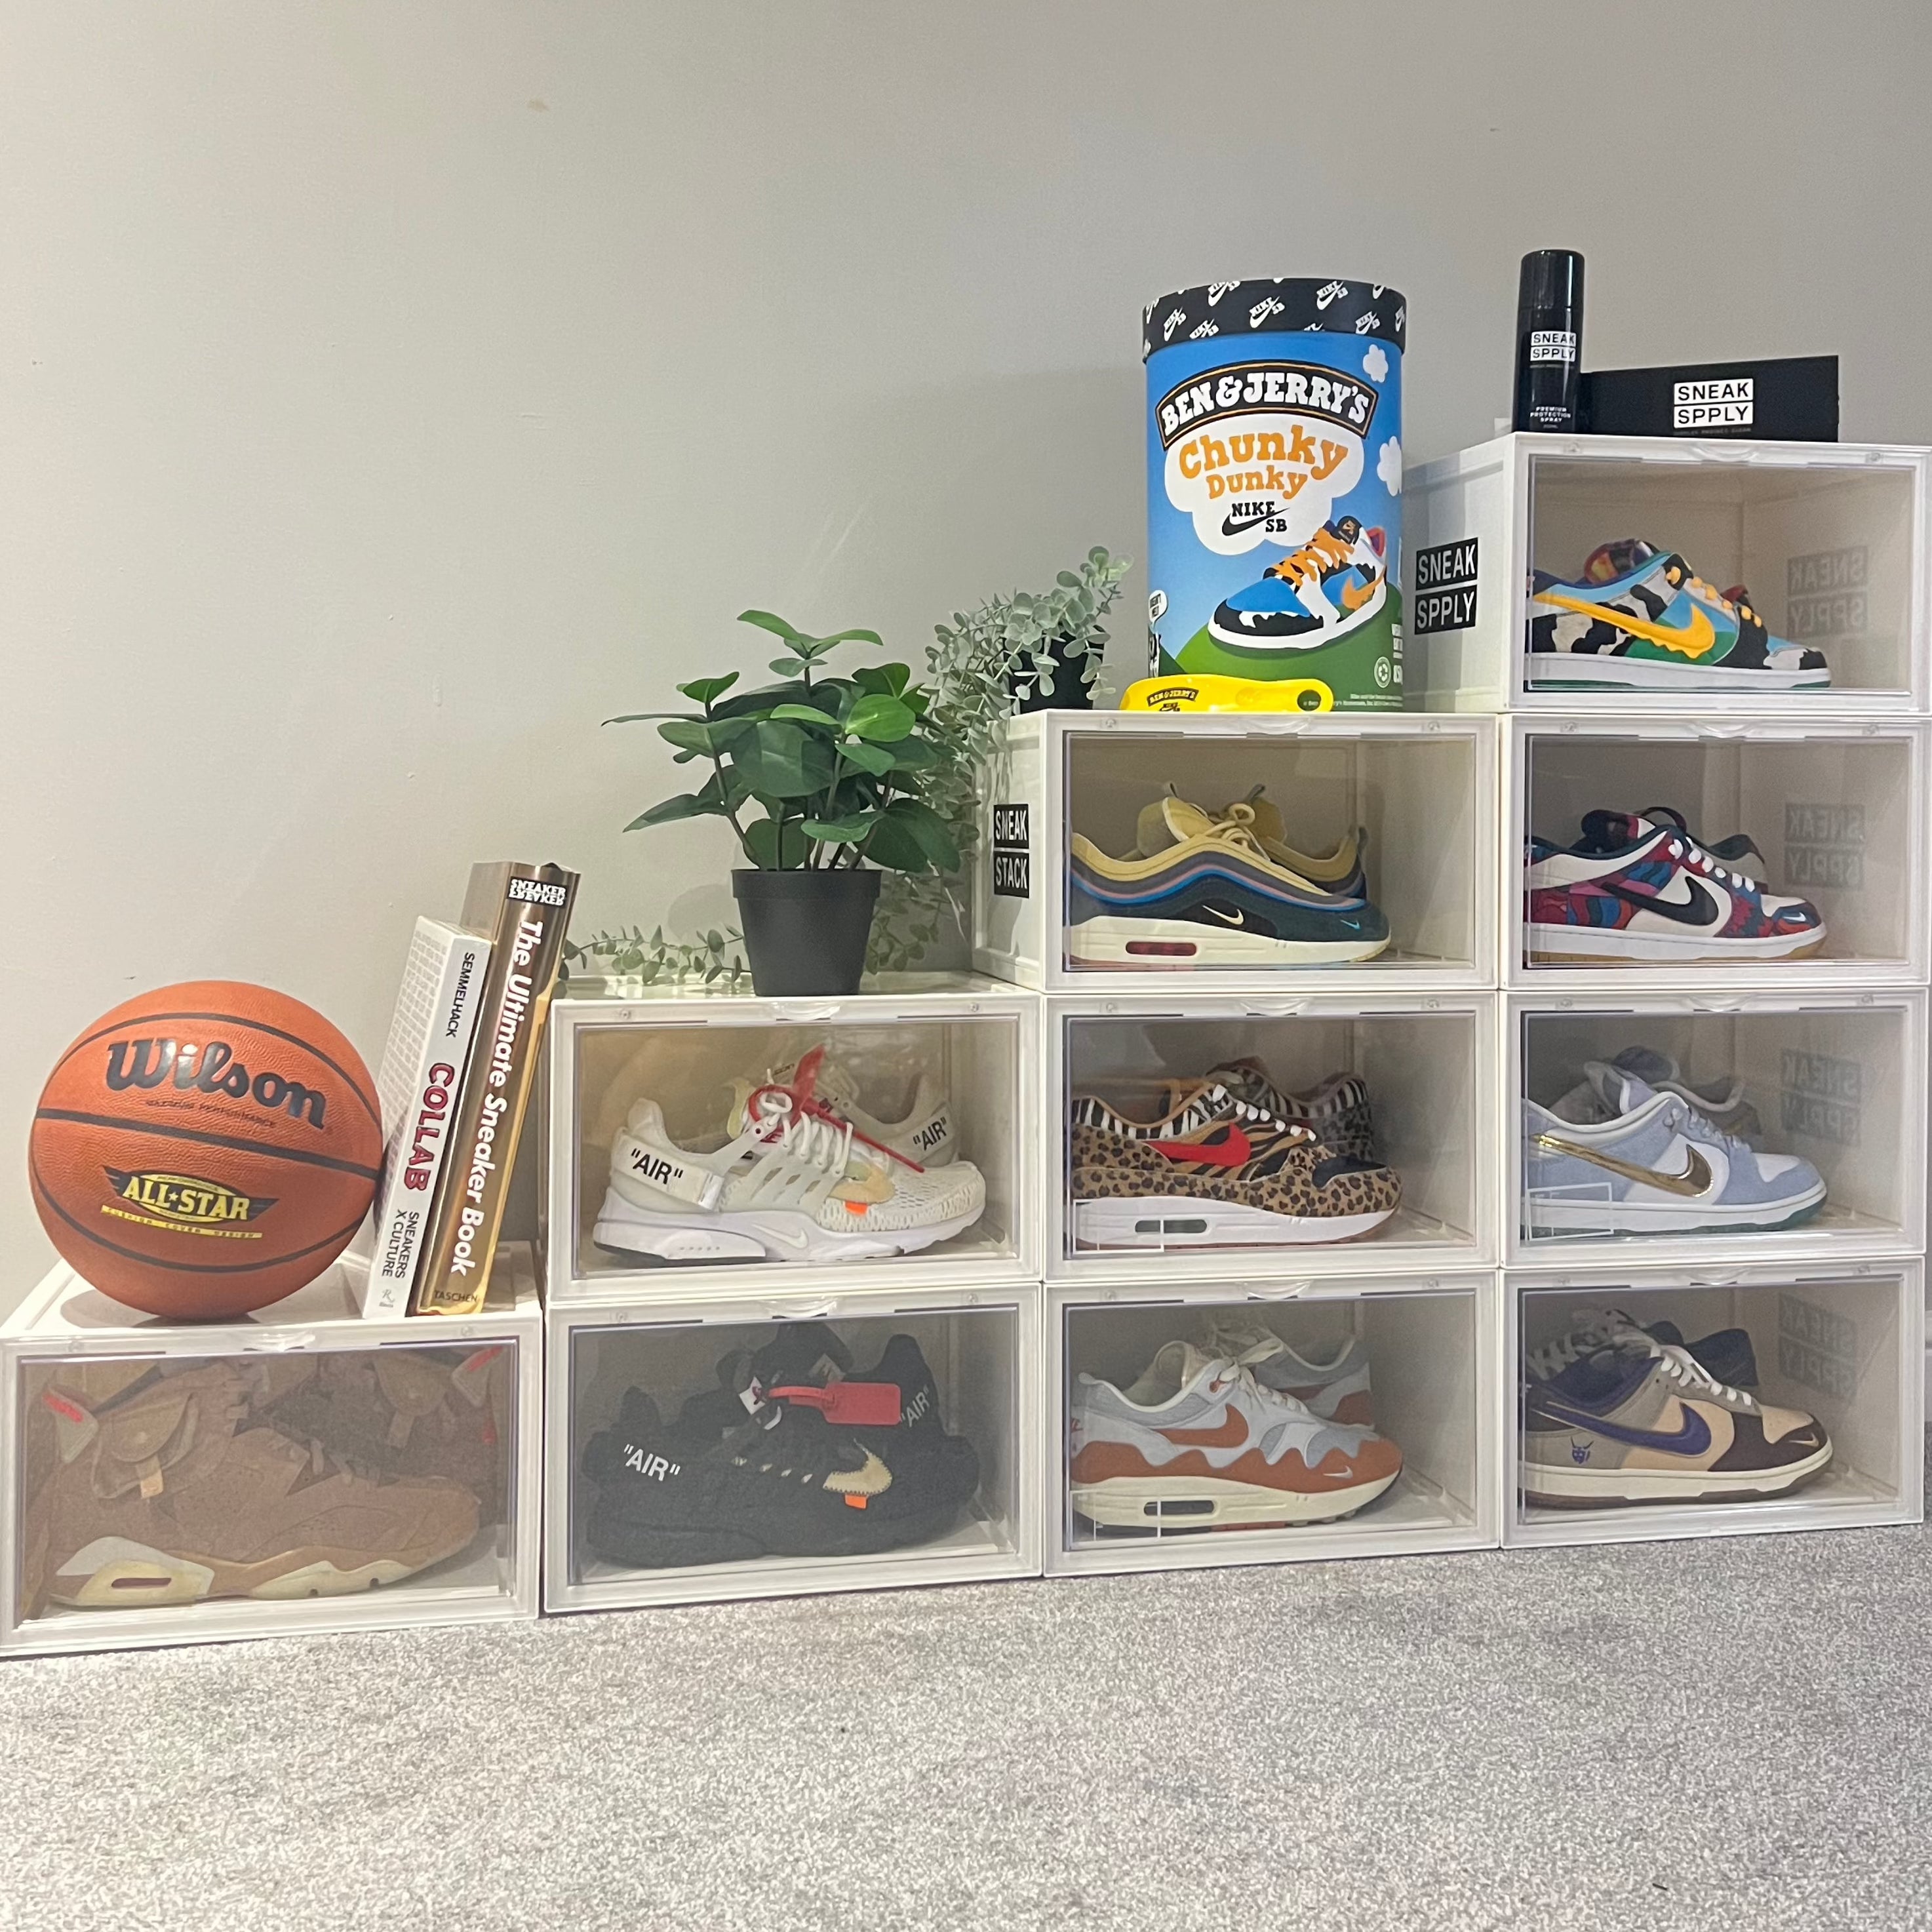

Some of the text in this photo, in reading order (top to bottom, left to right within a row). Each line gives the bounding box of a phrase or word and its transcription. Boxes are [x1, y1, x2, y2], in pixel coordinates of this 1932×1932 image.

[1249, 297, 1273, 317] NIKE
[1533, 333, 1575, 344] SNEAK
[1533, 348, 1575, 359] SPPLY
[1160, 372, 1369, 437] BEN & JERRY'S
[1678, 382, 1749, 401] SNEAK
[1678, 405, 1748, 424] SPPLY
[1179, 424, 1349, 481] Chunky
[1206, 465, 1309, 500] Dunky
[1231, 501, 1275, 517] NIKE
[1265, 519, 1288, 532] SB
[1418, 544, 1476, 585] SNEAK
[1417, 591, 1474, 629] SPPLY
[995, 810, 1027, 840] SNEAK
[511, 878, 566, 897] SNEAKER
[995, 856, 1027, 889] STACK
[445, 952, 475, 1038] SEMMELHACK
[106, 1037, 326, 1130] Wilson
[450, 921, 544, 1277] The Ultimate Sneaker Book
[404, 1061, 456, 1192] COLLAB
[913, 1116, 947, 1151] "AIR"
[631, 1148, 683, 1185] "AIR"
[122, 1175, 171, 1208] ALL
[177, 1189, 250, 1221] STAR
[382, 1209, 408, 1278] X CULTURE
[395, 1211, 420, 1279] SNEAKERS
[434, 1290, 479, 1303] TASCHEN
[623, 1444, 680, 1482] "AIR"
